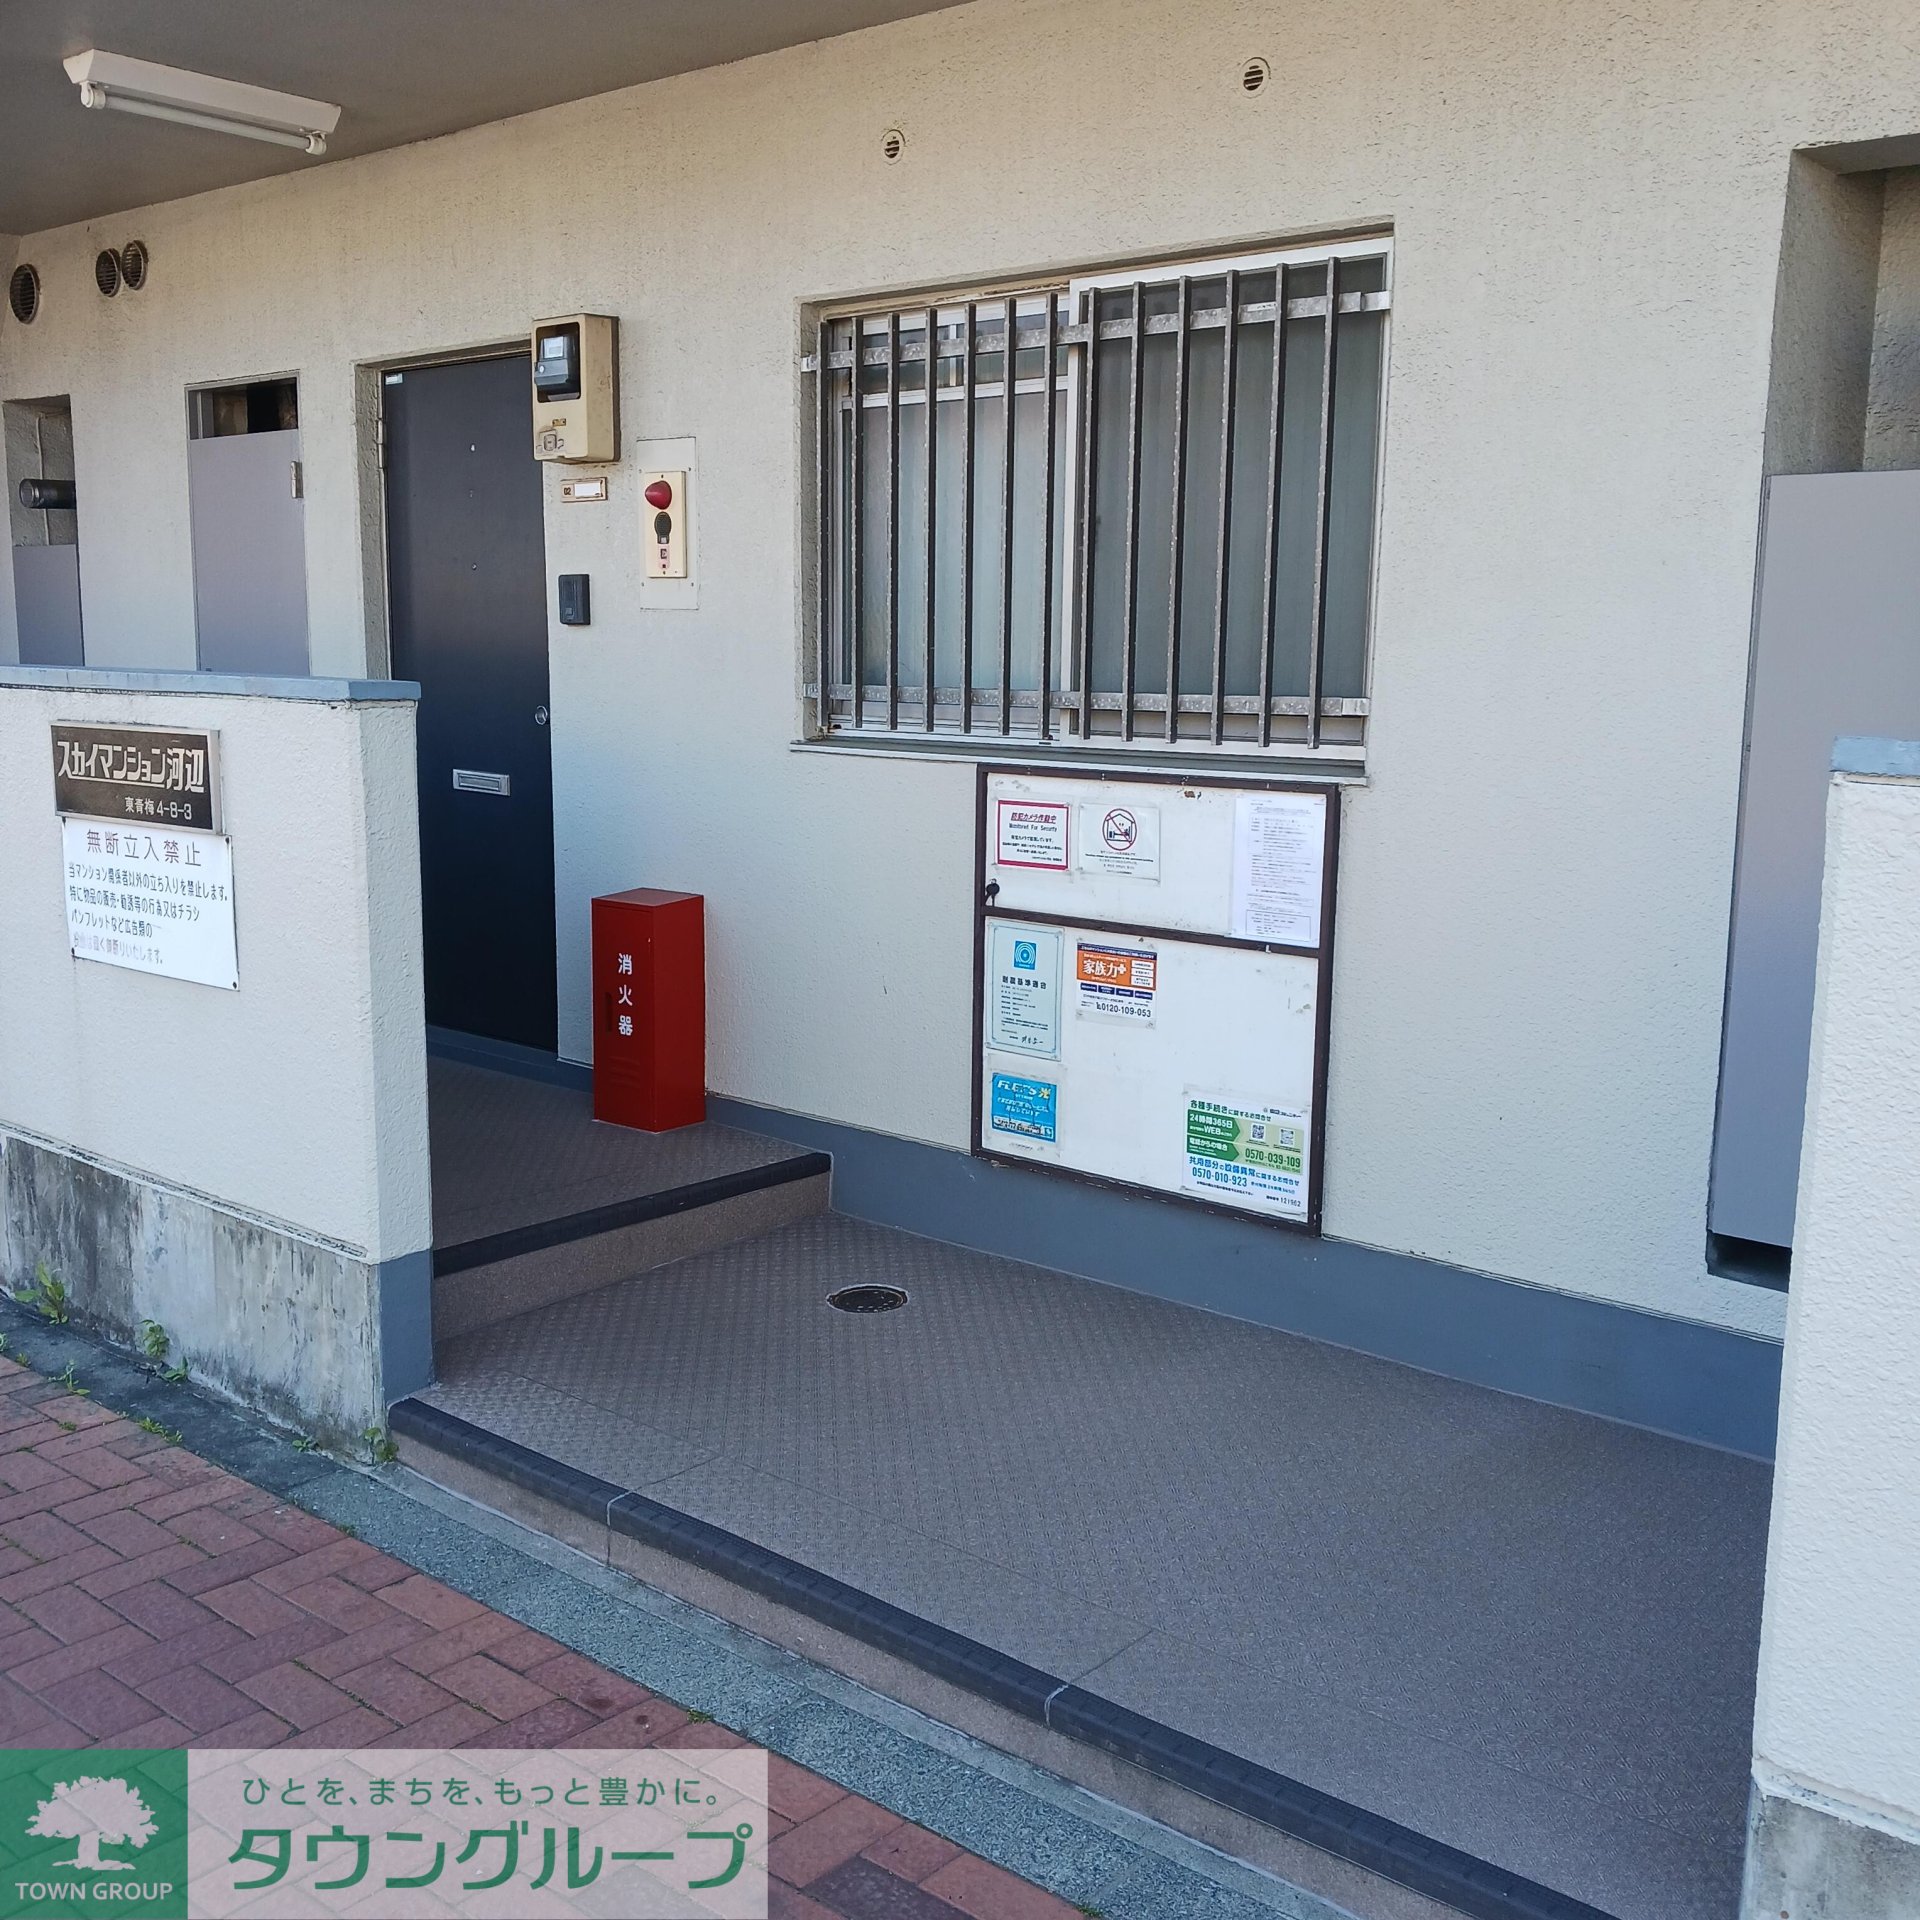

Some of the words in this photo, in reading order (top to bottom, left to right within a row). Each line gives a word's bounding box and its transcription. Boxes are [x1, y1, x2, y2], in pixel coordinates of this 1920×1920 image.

[57, 740, 205, 793] スカイマンション河辺
[124, 796, 193, 820] 東青梅4-8-3
[86, 829, 202, 867] 無断立入禁止
[618, 953, 634, 1036] 消火器
[1245, 1148, 1301, 1168] 0570-039-109
[1192, 1166, 1248, 1187] 0570-010-923
